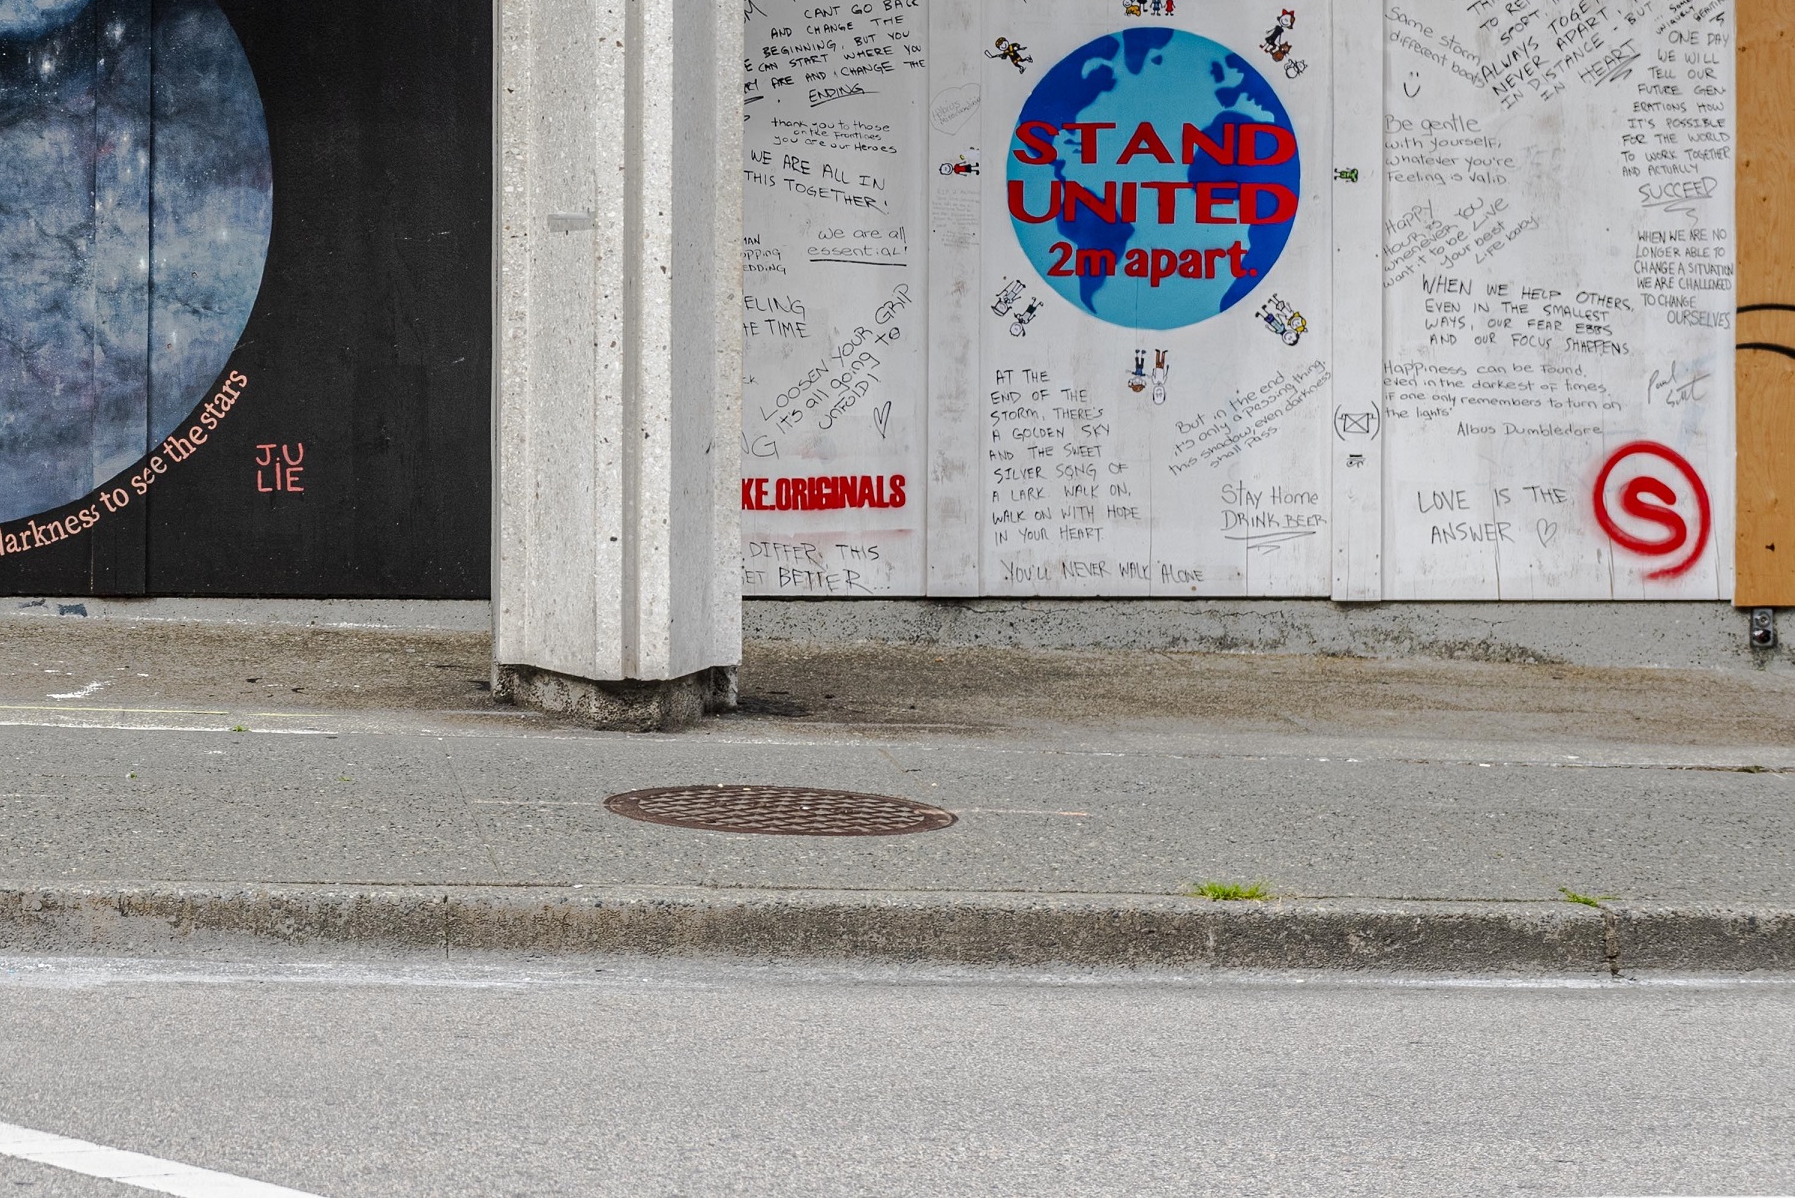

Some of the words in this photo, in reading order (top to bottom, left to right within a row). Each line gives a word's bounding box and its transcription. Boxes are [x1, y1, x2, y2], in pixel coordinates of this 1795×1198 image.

[804, 6, 840, 19] CANT
[852, 3, 872, 15] GO
[771, 28, 792, 39] AND
[807, 22, 854, 35] CHANGE
[870, 15, 904, 27] THE
[855, 35, 876, 46] BUT
[888, 31, 909, 39] YOU
[759, 63, 778, 72] CAN
[789, 54, 829, 68] START
[844, 46, 893, 60] WHERE
[904, 44, 921, 54] YOU
[772, 76, 794, 89] ARE
[805, 72, 826, 82] AND
[841, 61, 894, 76] CHANGE
[903, 60, 926, 69] THE
[808, 83, 865, 103] ENDING
[1386, 114, 1414, 132] Be
[1421, 114, 1482, 138] gentle
[1013, 121, 1297, 166] STAND
[744, 170, 775, 186] THIS
[751, 150, 772, 164] WE
[783, 155, 811, 174] ARE
[823, 164, 850, 185] ALL
[859, 175, 885, 191] IN
[1638, 176, 1718, 202] SUCCEED
[1008, 181, 1298, 224] UNITED
[853, 229, 882, 239] are
[889, 226, 906, 243] all
[1047, 242, 1116, 276] 2m
[1125, 240, 1257, 287] apart.
[1422, 274, 1472, 295] WHEN
[1487, 285, 1509, 297] WE
[1521, 289, 1562, 300] HELP
[764, 318, 811, 339] TIME
[760, 359, 829, 421] LOOSEN
[832, 326, 873, 367] YOUR
[875, 283, 912, 324] GRIP
[996, 370, 1013, 385] AT
[1022, 369, 1050, 383] THE
[100, 484, 129, 513] to
[131, 455, 166, 496] see
[163, 425, 208, 462] the
[200, 368, 248, 431] stars
[1270, 486, 1318, 505] Home
[1418, 489, 1470, 513] LOVE
[1495, 488, 1511, 506] IS
[1523, 485, 1568, 503] THE
[1221, 510, 1279, 531] DRINK
[1283, 515, 1327, 528] BEER
[1431, 521, 1515, 544] ANSWER
[836, 545, 879, 560] THIS
[1062, 561, 1111, 579] NEVER
[1119, 562, 1150, 580] WALK
[1161, 564, 1204, 584] ALONE
